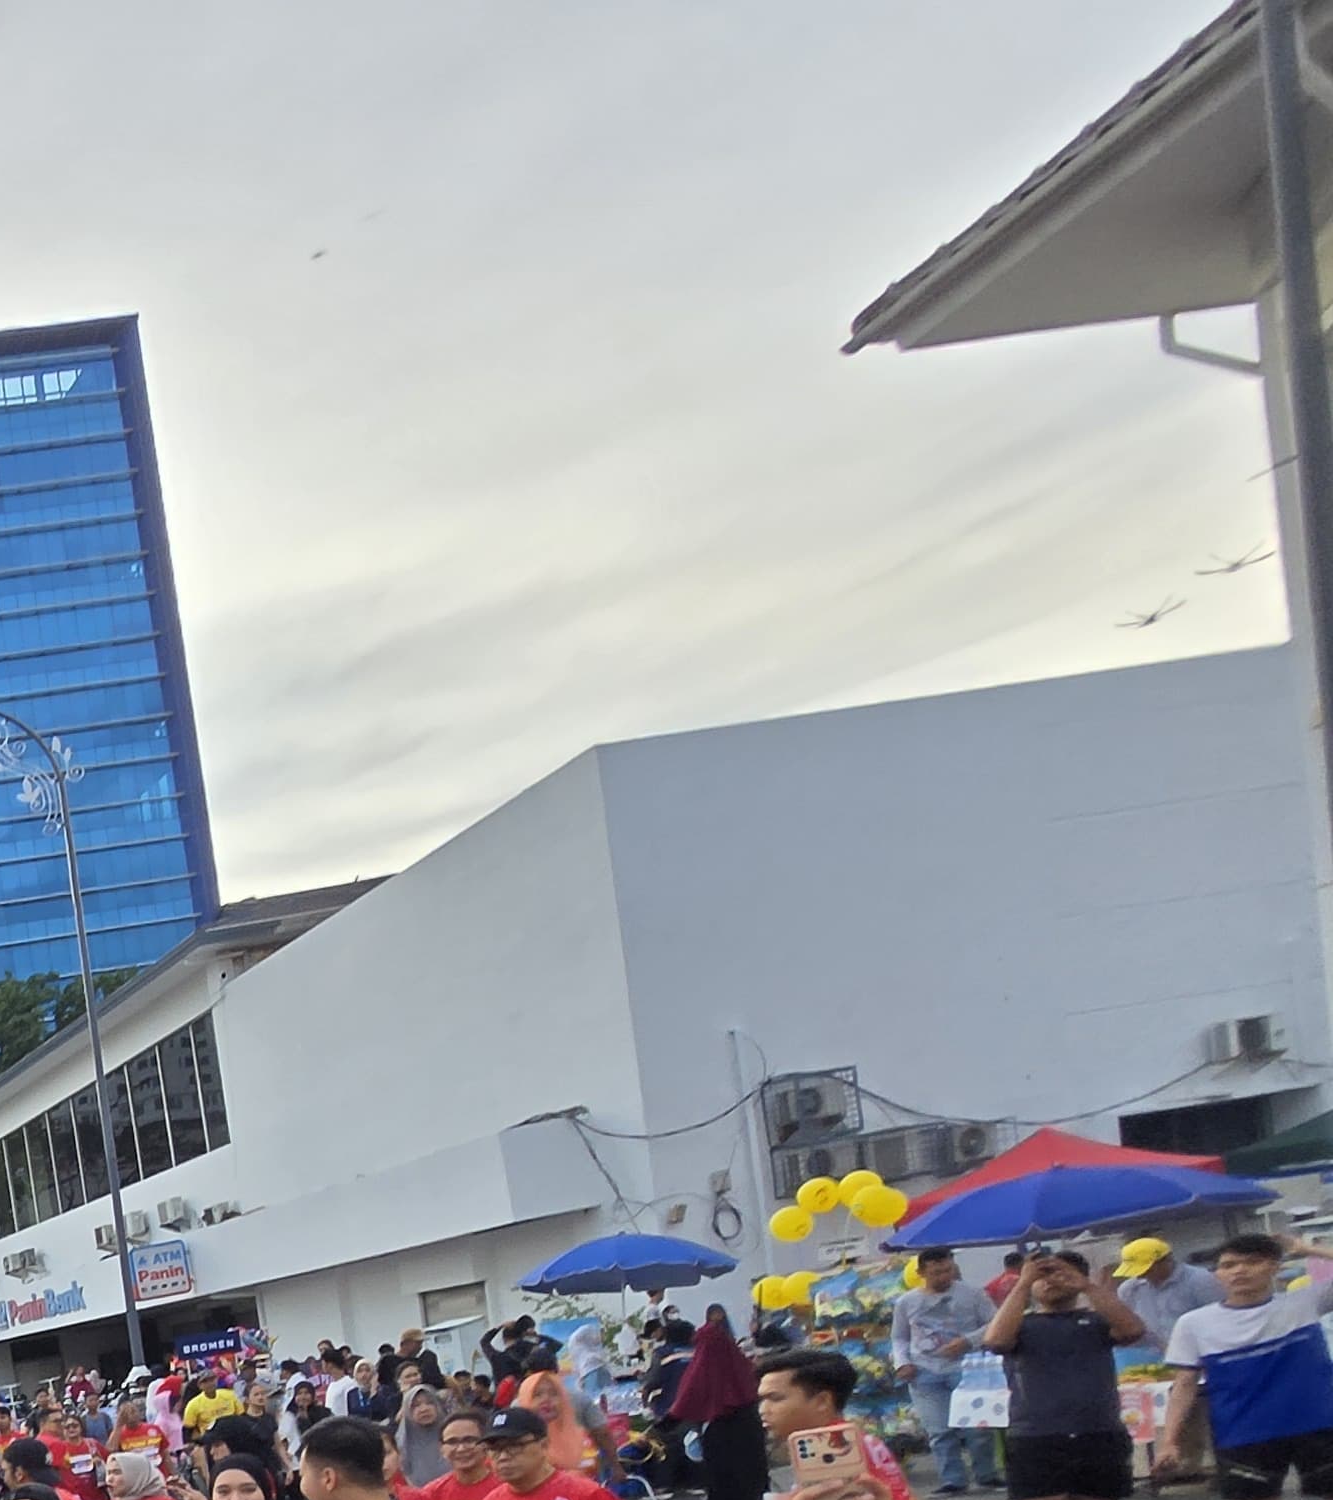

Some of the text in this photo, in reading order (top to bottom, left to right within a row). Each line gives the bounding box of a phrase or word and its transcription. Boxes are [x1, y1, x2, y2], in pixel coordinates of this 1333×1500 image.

[153, 1250, 182, 1264] ATM
[137, 1265, 185, 1282] Panin
[8, 1281, 87, 1327] PaninBank
